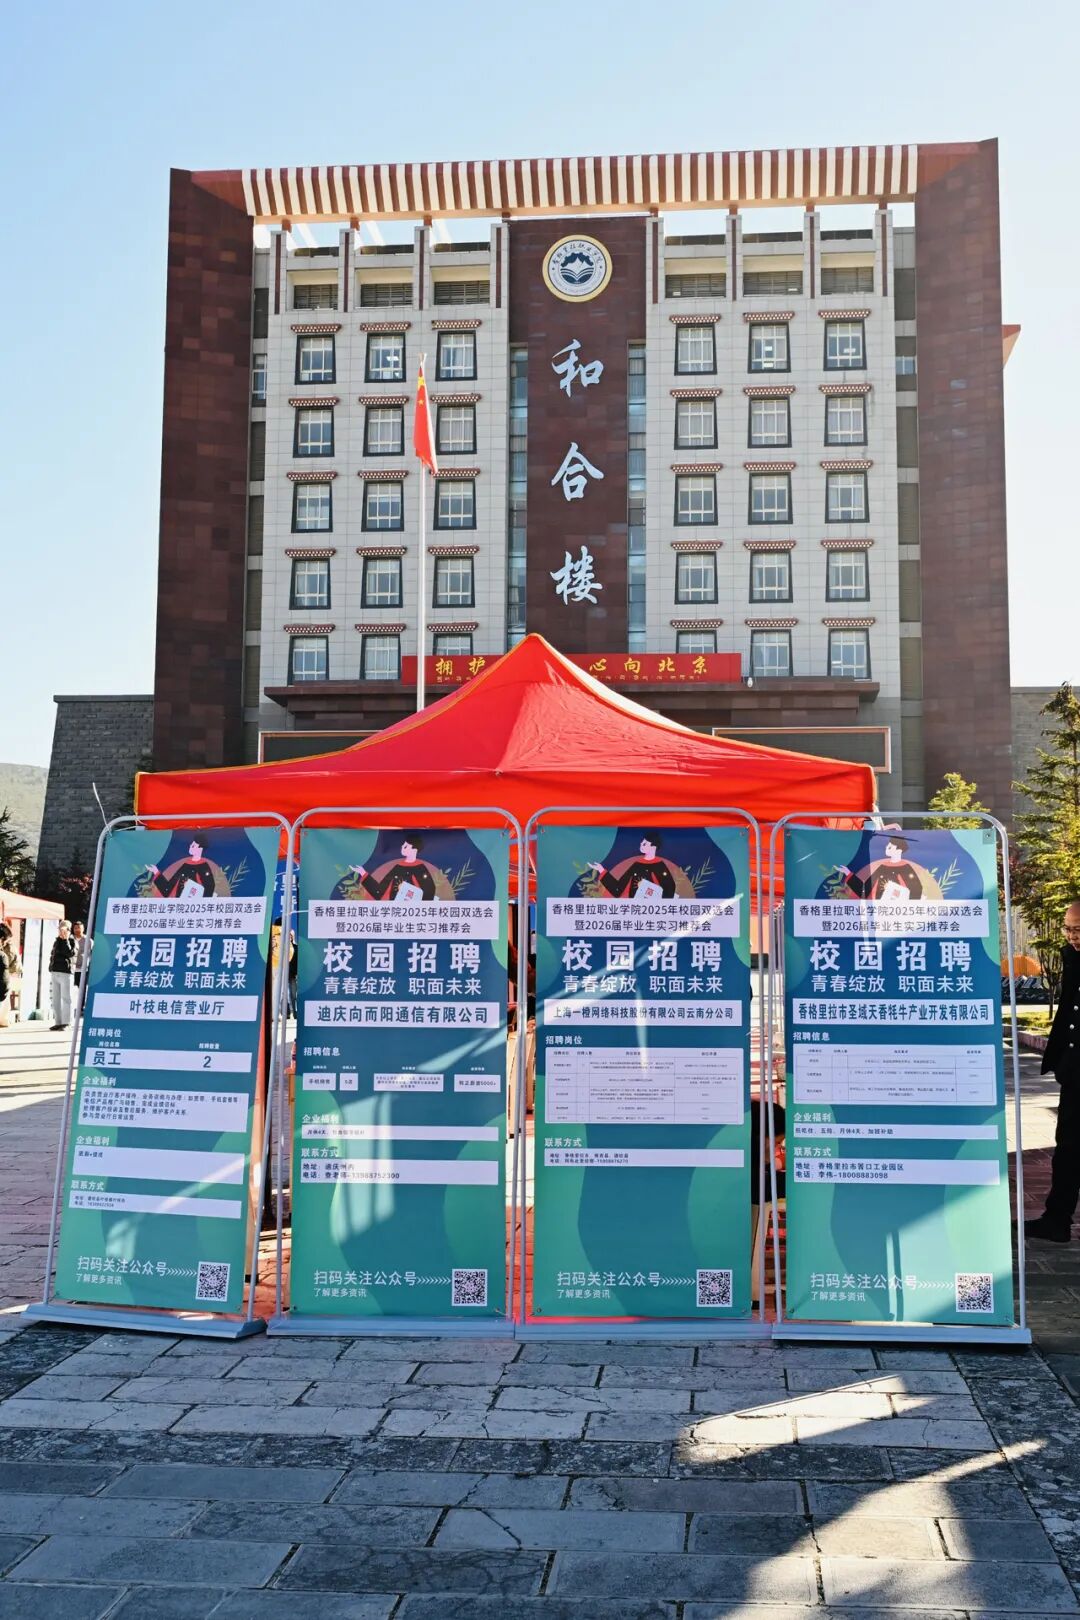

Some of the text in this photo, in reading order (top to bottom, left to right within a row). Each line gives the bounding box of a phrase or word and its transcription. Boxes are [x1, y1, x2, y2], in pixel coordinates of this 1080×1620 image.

[551, 338, 604, 605] 和合楼
[435, 656, 707, 676] 拥护 心向北京
[112, 903, 263, 914] 香格里拉职业学院2025年校园双选会
[314, 906, 493, 918] 香格里拉职业学院2025年校园双选会
[552, 904, 734, 916] 香格里拉职业学院2025年校园双选会
[799, 905, 983, 916] 香格里拉职业学院2025年校园双选会
[128, 918, 242, 929] 暨2026届毕业生实习推荐会
[336, 922, 471, 934] 暨2026届毕业生实习推荐会
[574, 920, 712, 931] 暨2026届毕业生实习推荐会
[822, 921, 961, 932] 暨2026届毕业生实习推荐会
[115, 937, 249, 969] 校园招聘
[323, 941, 481, 974] 校园招聘
[562, 939, 722, 972] 校园招聘
[809, 939, 972, 972] 校园招聘
[114, 971, 247, 990] 青春绽放 职面未来
[324, 977, 482, 995] 青春绽放 职面未来
[563, 975, 723, 994] 青春绽放 职面未来
[811, 975, 974, 994] 青春绽放 职面未来
[129, 1000, 225, 1016] 叶枝电信营业厅
[553, 1006, 733, 1019] 上海一橙网络科技股份有限公司云南分公司
[798, 1003, 989, 1021] 香格里拉市圣域天香牦牛产业开发有限公司
[317, 1006, 488, 1024] 迪庆向而阳通信有限公司
[88, 1028, 122, 1038] 招聘岗位
[792, 1031, 830, 1042] 招聘信息
[545, 1035, 583, 1045] 招聘岗位
[303, 1046, 341, 1057] 招聘信息
[93, 1051, 212, 1068] 员工 2
[83, 1075, 117, 1086] 企业福利
[302, 1114, 340, 1124] 企业福利
[793, 1112, 832, 1122] 企业福利
[76, 1135, 110, 1146] 企业福利
[544, 1137, 582, 1147] 联系方式
[302, 1147, 339, 1158] 联系方式
[793, 1146, 832, 1157] 联系方式
[71, 1179, 104, 1191] 联系方式
[77, 1256, 168, 1277] 扫码关注公众号
[76, 1273, 123, 1286] 了解更多资讯
[314, 1270, 417, 1286] 扫码关注公众号
[557, 1271, 661, 1287] 扫码关注公众号
[810, 1272, 917, 1290] 扫码关注公众号
[314, 1288, 367, 1298] 了解更多资讯
[557, 1289, 611, 1299] 了解更多资讯
[809, 1291, 866, 1301] 了解更多资讯
